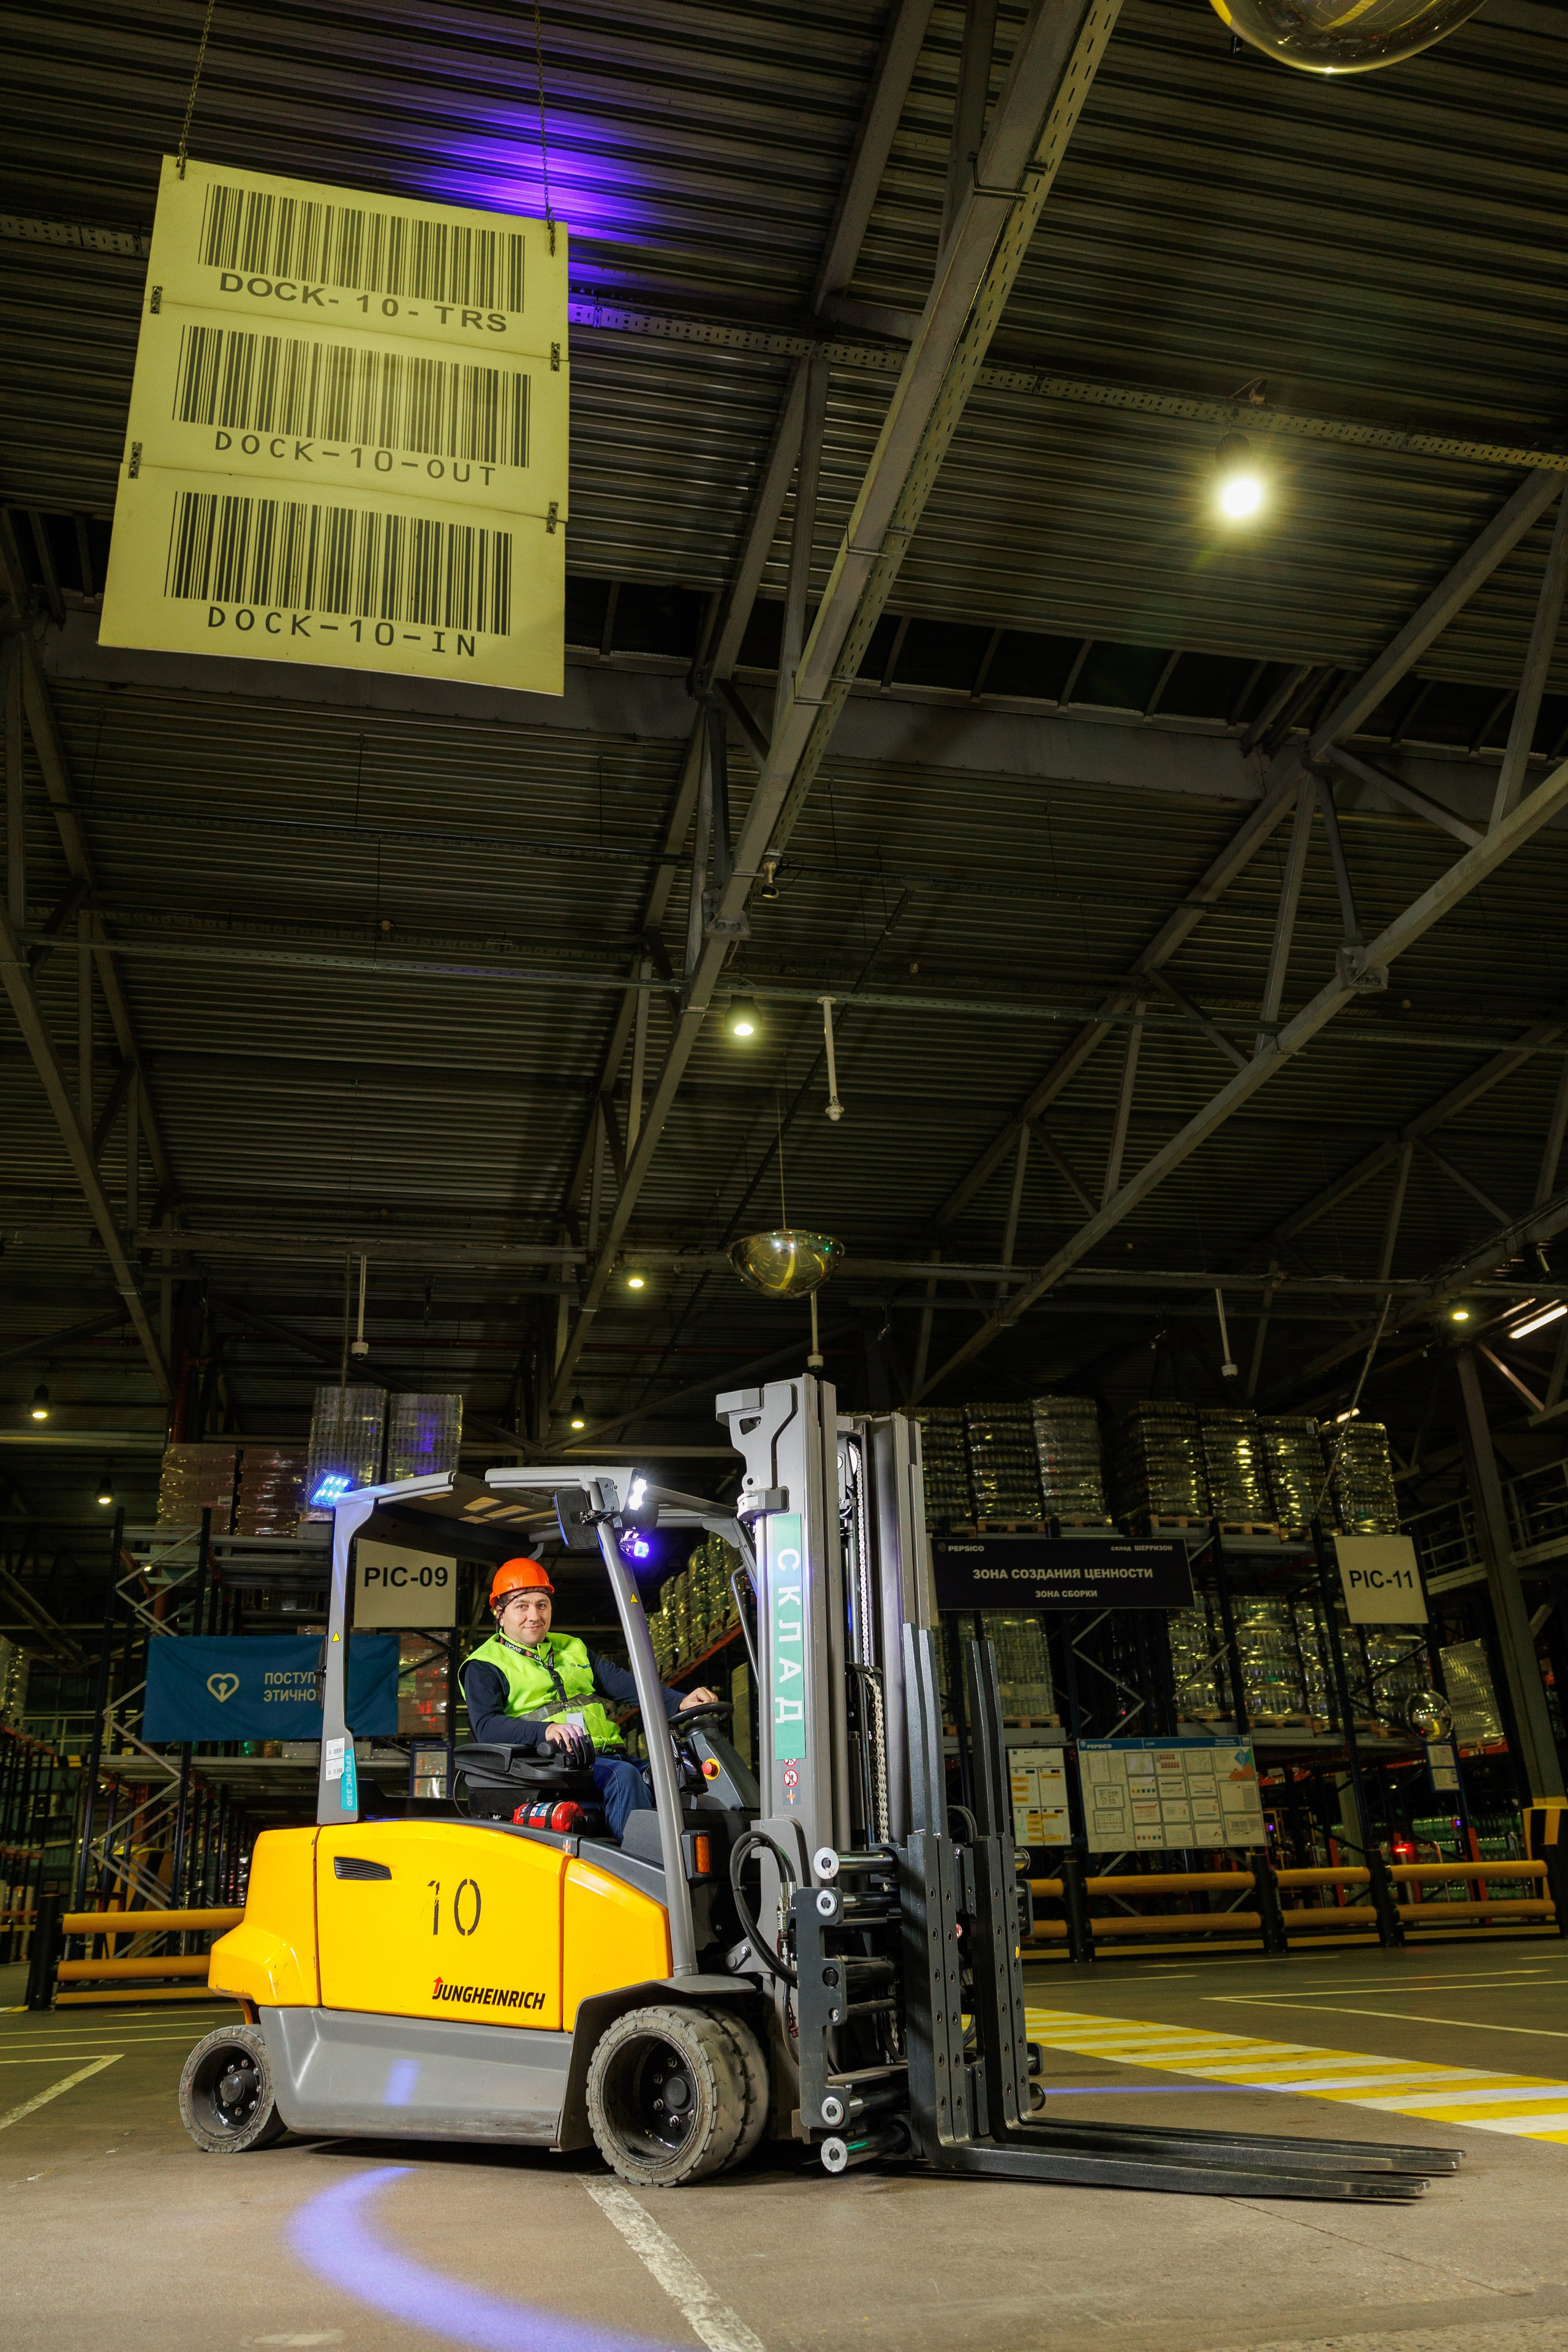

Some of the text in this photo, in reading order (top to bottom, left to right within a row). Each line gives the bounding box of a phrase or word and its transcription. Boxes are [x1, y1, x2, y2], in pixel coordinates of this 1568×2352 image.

[214, 431, 496, 486] DOCK-10-OUT
[207, 606, 476, 657] DOCK-10-IN
[364, 1567, 448, 1587] PIC-09
[973, 1569, 1153, 1580] ЗОНА СОЗДАНИЯ ЦЕННОСТИ
[1349, 1570, 1413, 1588] PIC-11
[775, 1548, 803, 1724] СКЛАД
[505, 1642, 521, 1653] DUCATI
[265, 1672, 316, 1684] ПОСТУП
[263, 1689, 317, 1702] ЭТИЧНО
[346, 1774, 352, 1787] MC
[427, 1879, 481, 1936] 10
[432, 1983, 546, 2010] JUNGHEINRICH
